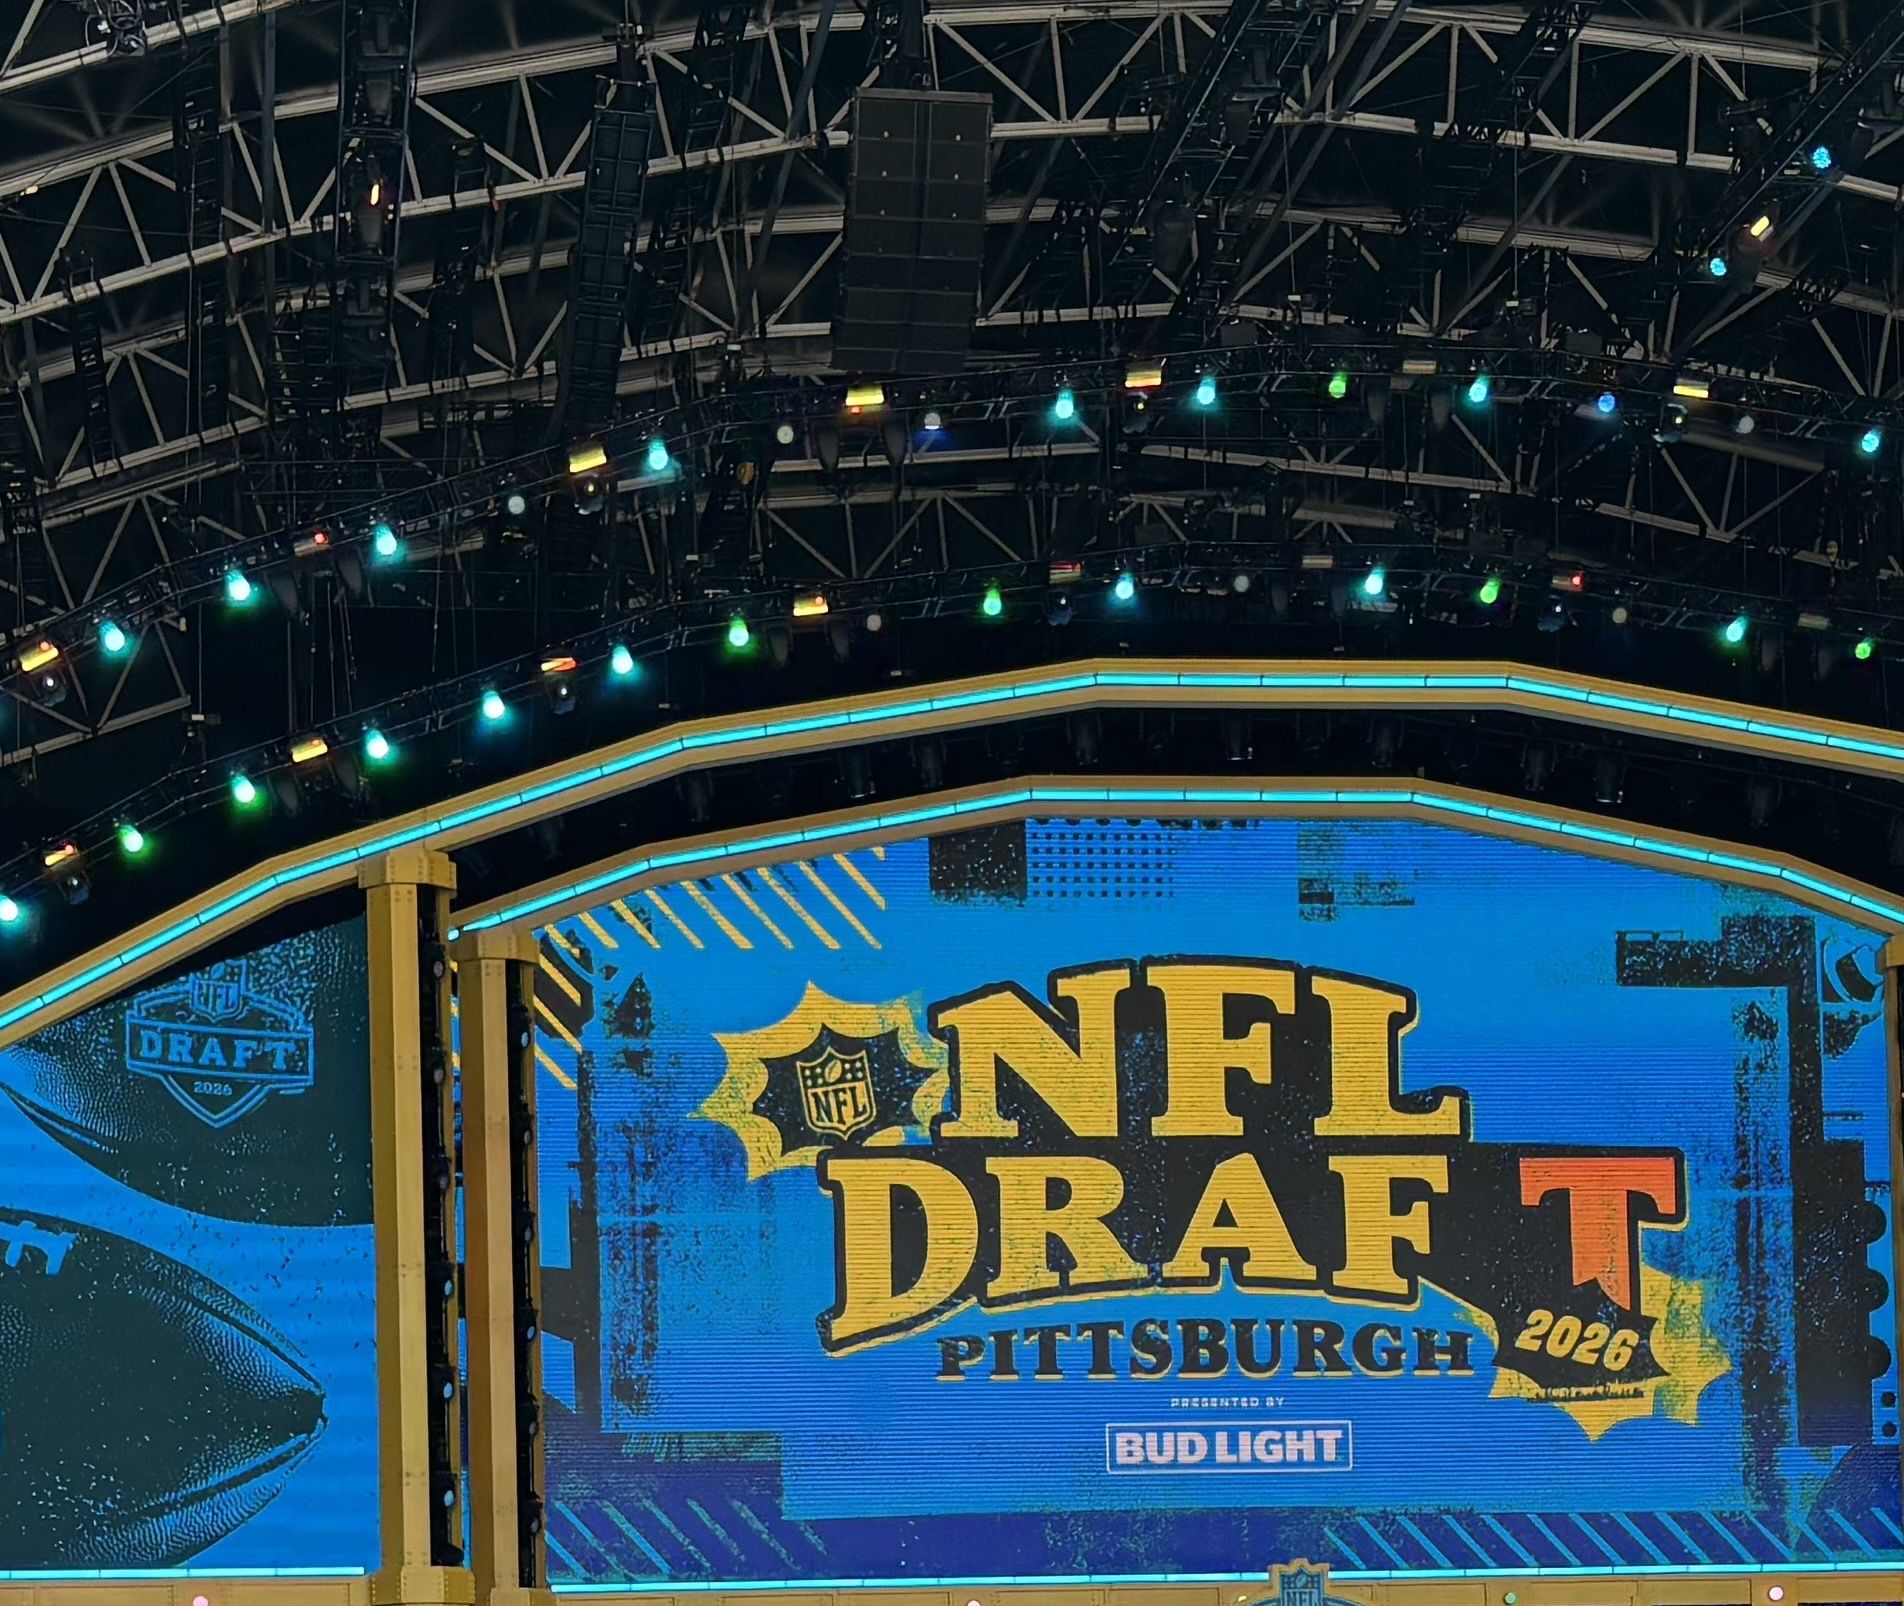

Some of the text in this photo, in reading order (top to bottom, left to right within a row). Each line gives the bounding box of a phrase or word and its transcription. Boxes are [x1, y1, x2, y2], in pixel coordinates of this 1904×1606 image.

[139, 1030, 297, 1071] DRAFT
[934, 964, 1464, 1139] NFL
[193, 1081, 233, 1096] 2026
[810, 1085, 868, 1128] NFL
[934, 1318, 1474, 1379] PITTSBURGH
[1514, 1309, 1640, 1372] 2026
[1170, 1396, 1285, 1409] PRESENTED BY
[1114, 1429, 1344, 1465] BUD LIGHT
